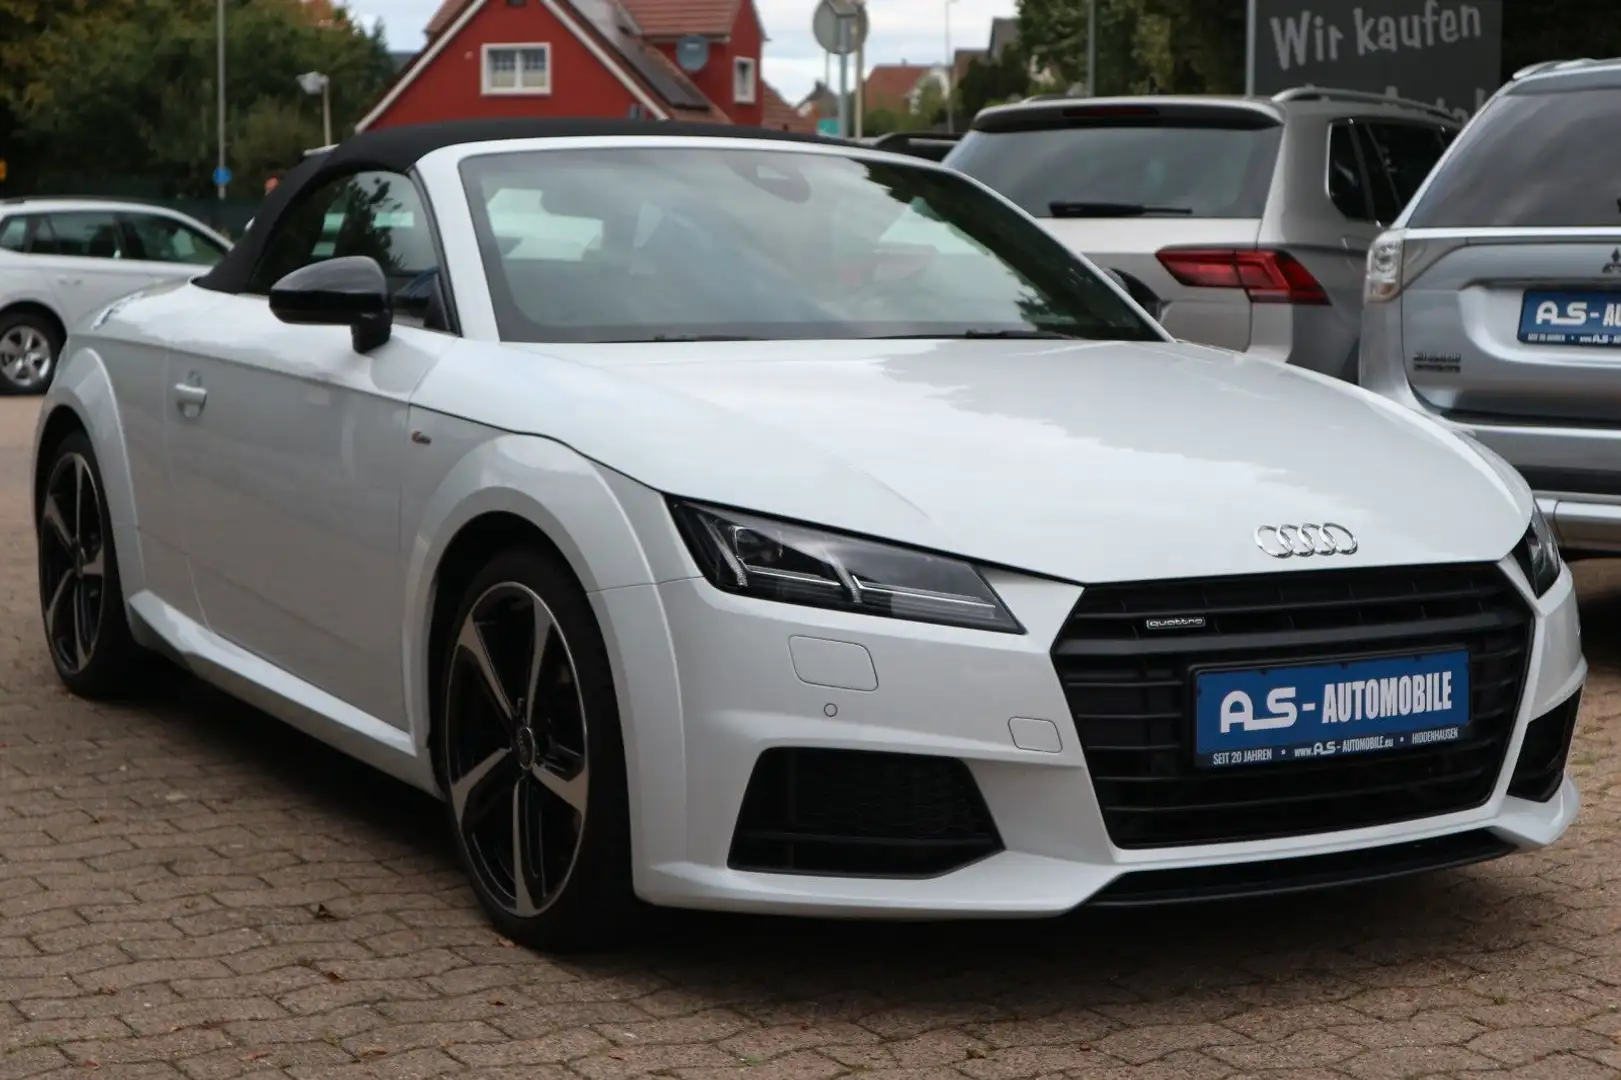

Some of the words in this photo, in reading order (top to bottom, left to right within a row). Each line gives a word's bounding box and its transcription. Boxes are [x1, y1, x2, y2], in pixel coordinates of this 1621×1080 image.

[1269, 10, 1344, 71] Wir
[1353, 0, 1481, 56] kaufen
[1213, 752, 1230, 765] SEIT
[1231, 751, 1242, 763] 20
[1243, 748, 1272, 763] JAHREN
